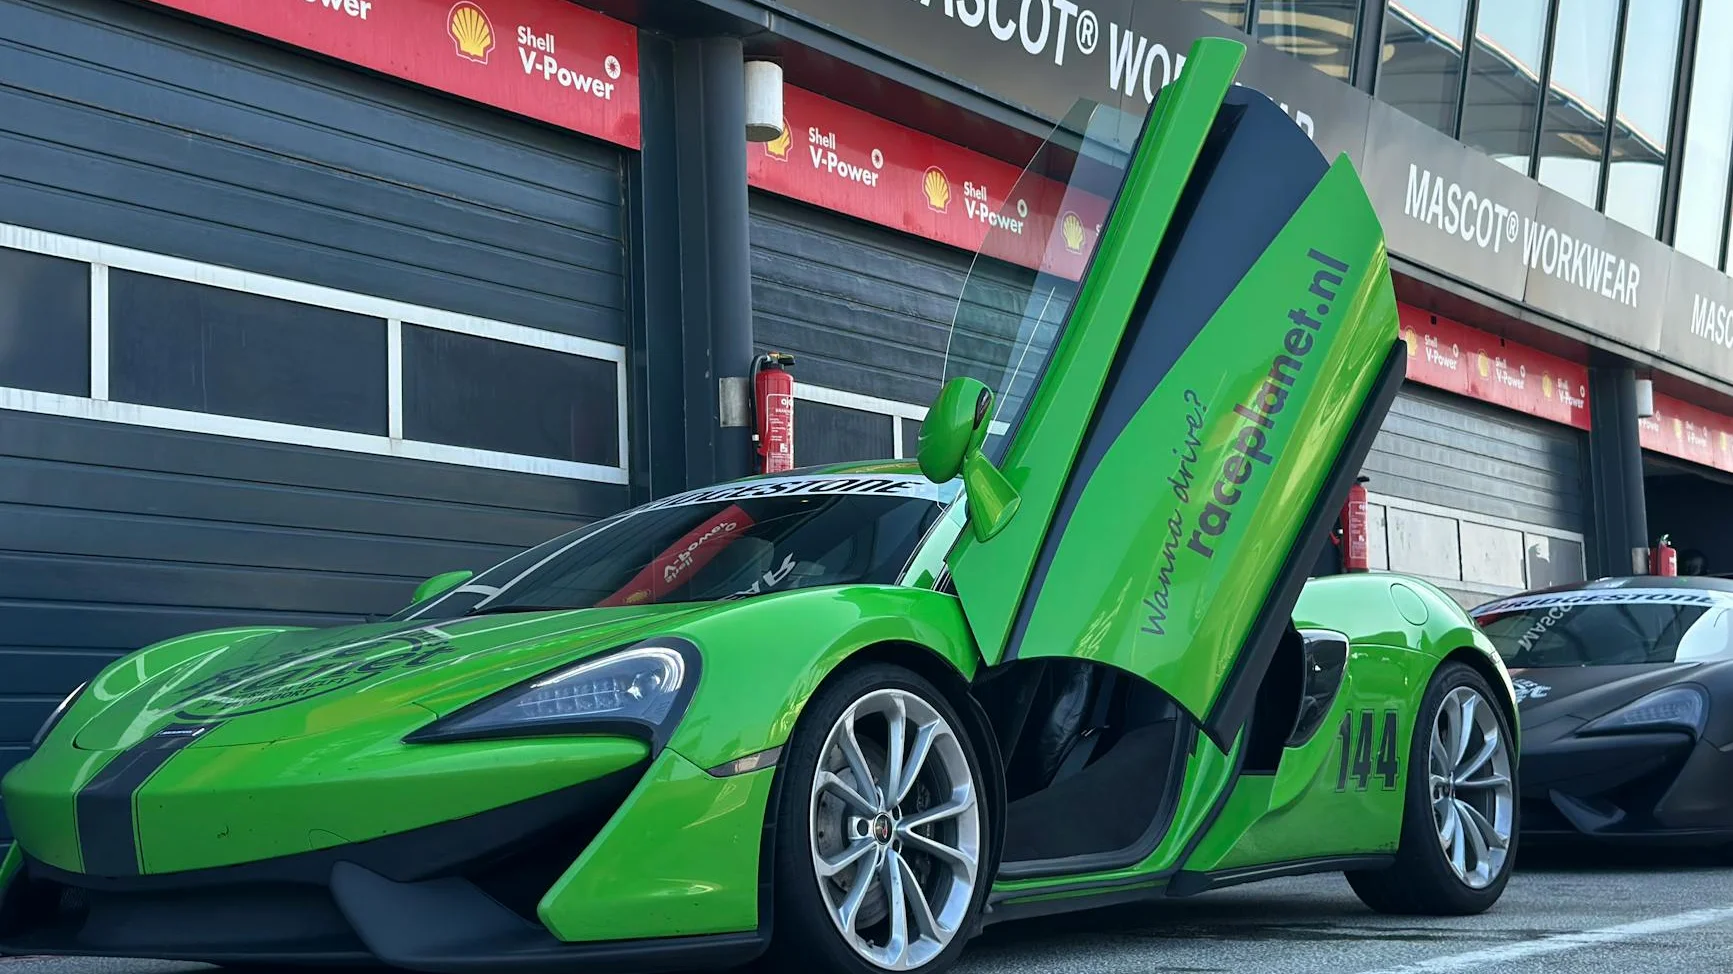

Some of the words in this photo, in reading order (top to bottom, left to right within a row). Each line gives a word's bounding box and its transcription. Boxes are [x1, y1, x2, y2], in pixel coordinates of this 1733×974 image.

[517, 25, 555, 54] Shell
[518, 46, 615, 100] V-Power
[808, 126, 836, 150] Shell
[809, 145, 879, 188] V-Power
[963, 181, 987, 202] Shell
[964, 197, 1024, 235] V-Power
[1522, 217, 1641, 308] WORKWEAR
[1425, 346, 1457, 370] V-Power
[1186, 248, 1350, 560] raceplanet.nl
[1140, 508, 1183, 636] Wanna
[1166, 388, 1208, 504] drive?
[1335, 708, 1400, 793] 144
